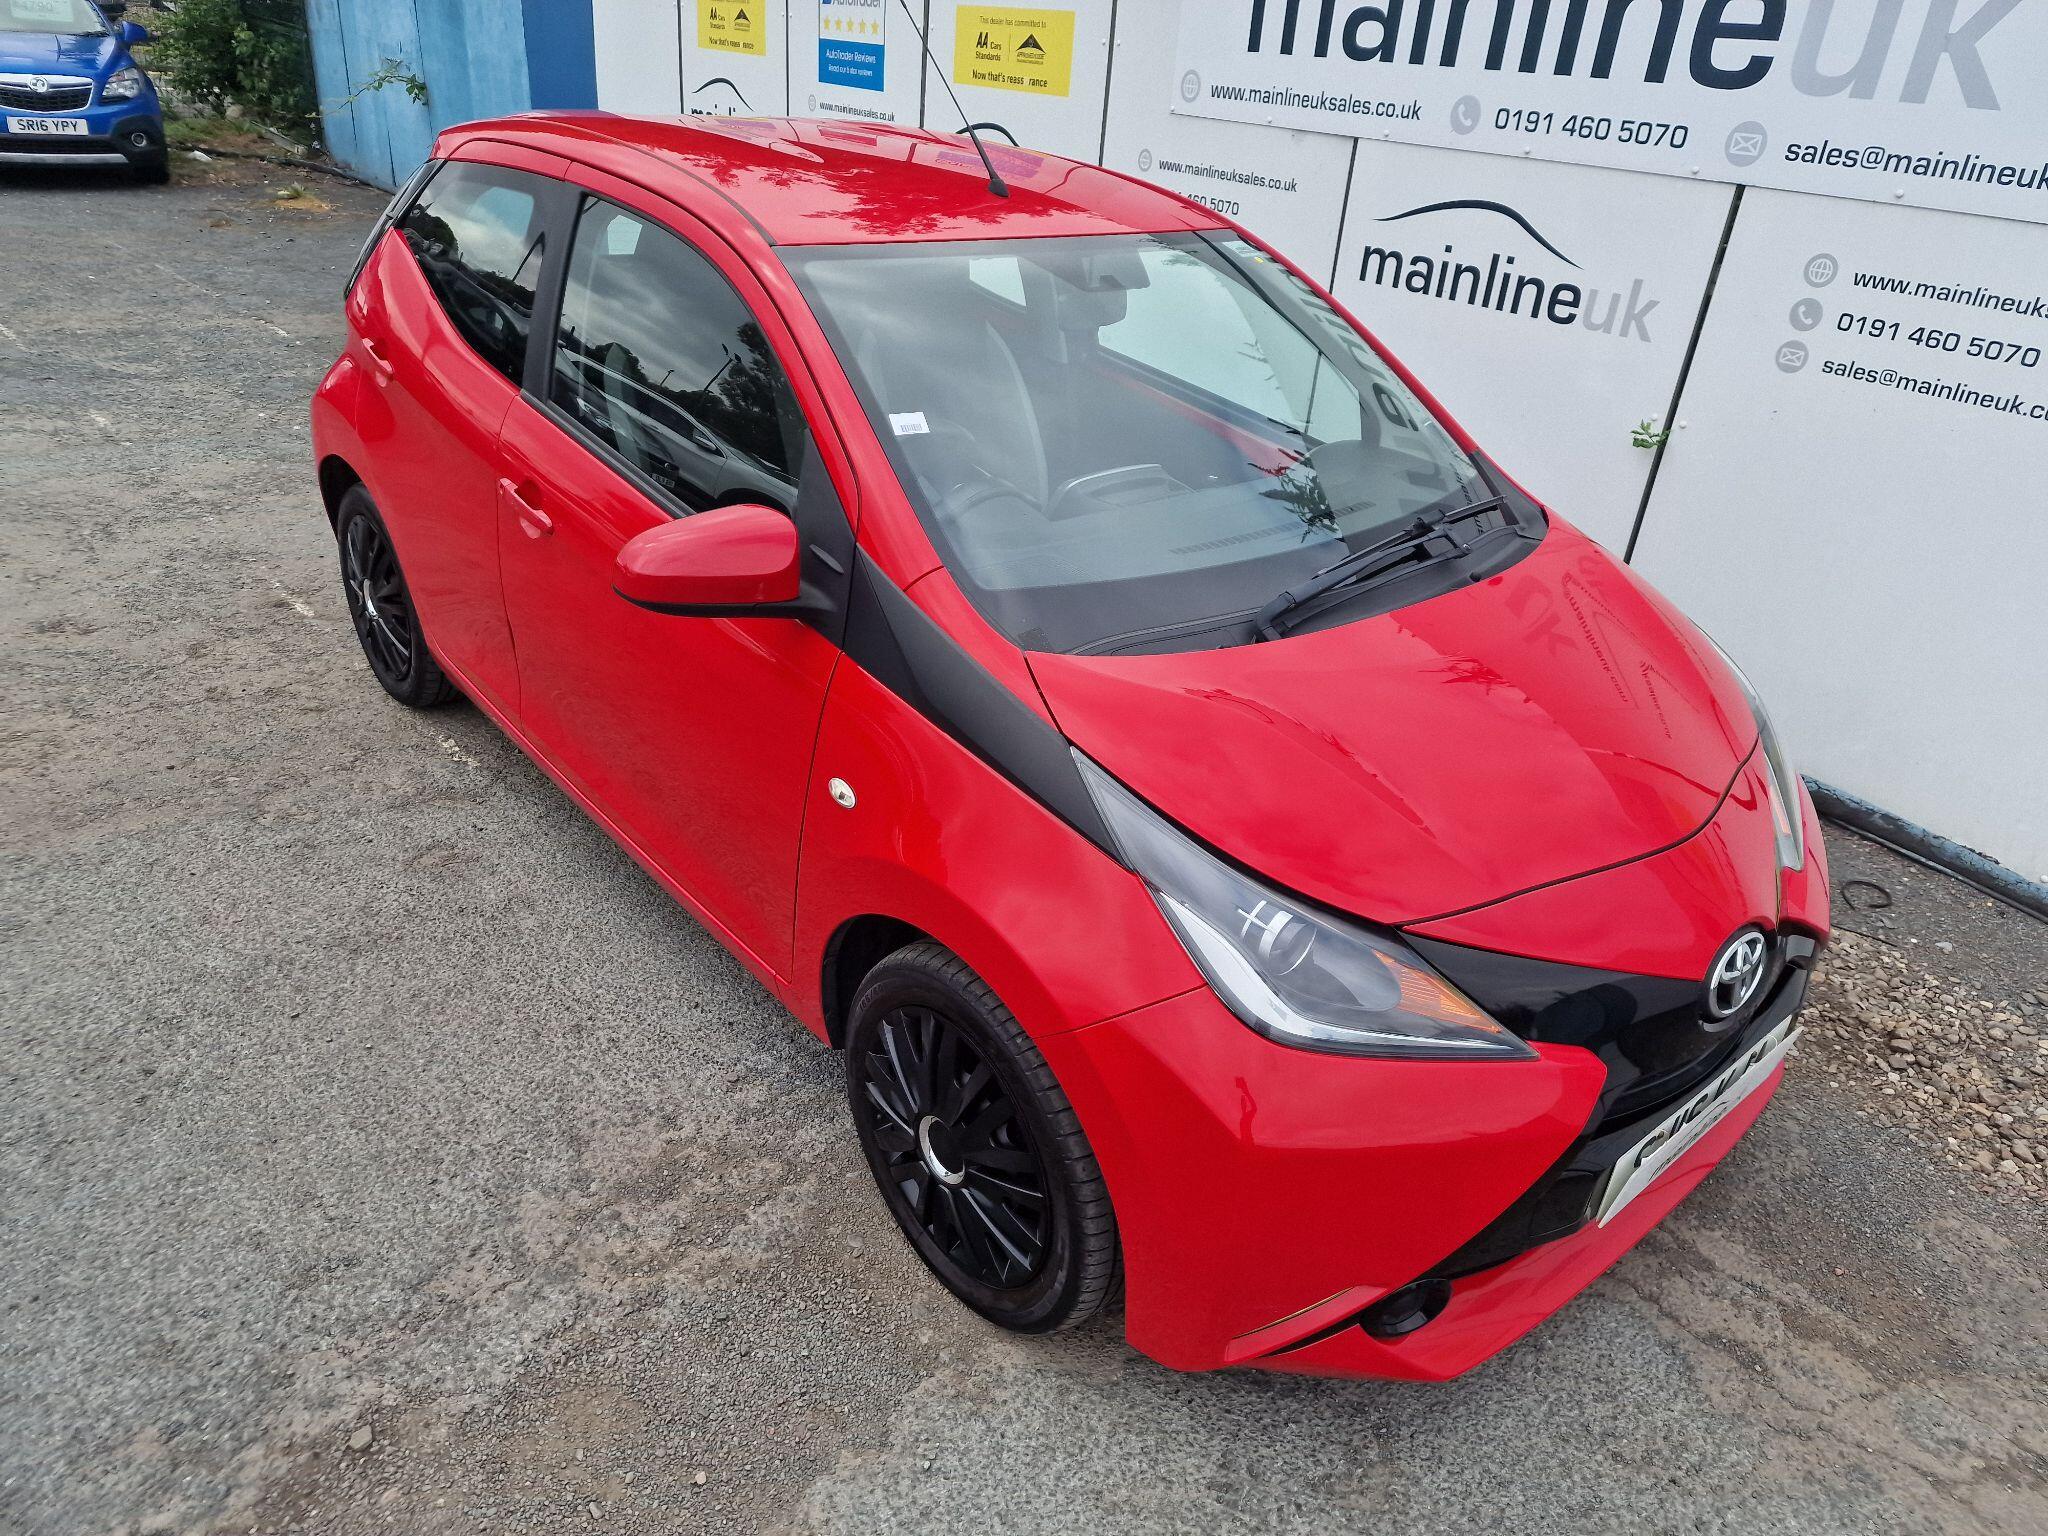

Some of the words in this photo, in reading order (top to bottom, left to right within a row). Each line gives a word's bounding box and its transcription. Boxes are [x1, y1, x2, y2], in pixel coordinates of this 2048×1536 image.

[989, 18, 1004, 26] dealer
[1005, 18, 1014, 26] has
[1014, 20, 1041, 28] committed
[1041, 20, 1047, 28] to
[976, 32, 989, 49] AA
[990, 41, 1002, 51] Cars
[826, 48, 854, 62] AutoTrader
[975, 51, 1001, 61] Standards
[972, 69, 987, 81] Now
[987, 71, 1005, 83] that's
[17, 119, 49, 132] SR16
[52, 120, 78, 132] YPY
[1211, 84, 1422, 120] www.mainlineuksales.co.uk
[1495, 107, 1553, 134] 0191
[1562, 115, 1611, 140] 460
[1618, 120, 1689, 148] 5070
[1159, 159, 1298, 193] www.mainlineuksales.co.uk
[1210, 197, 1240, 216] 5070
[1359, 244, 1661, 343] mainlineuk
[1837, 312, 1901, 341] 0191
[1908, 326, 1961, 352] 460
[1967, 336, 2041, 368] 5070
[1822, 360, 2048, 422] sales@mainlineuk.c
